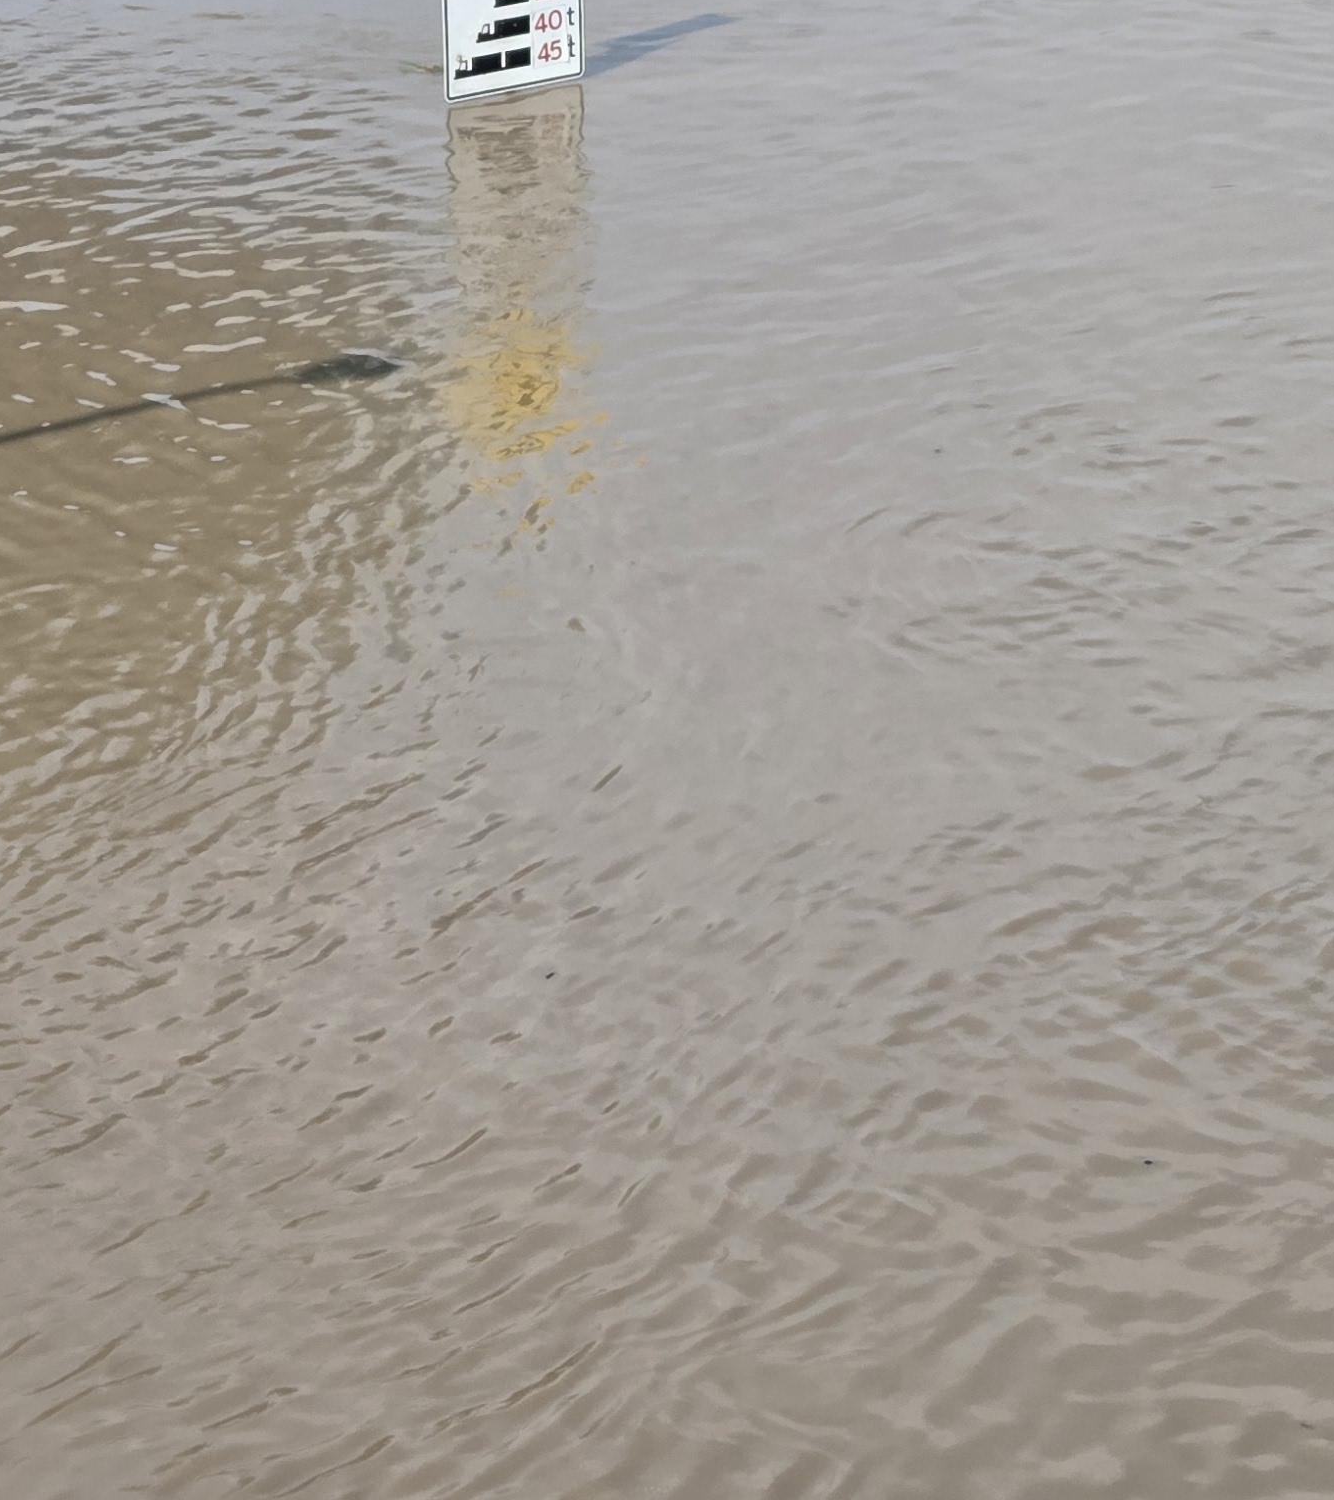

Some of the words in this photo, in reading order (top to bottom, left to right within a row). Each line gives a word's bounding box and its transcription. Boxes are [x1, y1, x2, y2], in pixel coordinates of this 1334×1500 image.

[534, 9, 563, 33] 40
[566, 7, 575, 27] t
[537, 39, 563, 63] 45
[567, 36, 576, 58] t
